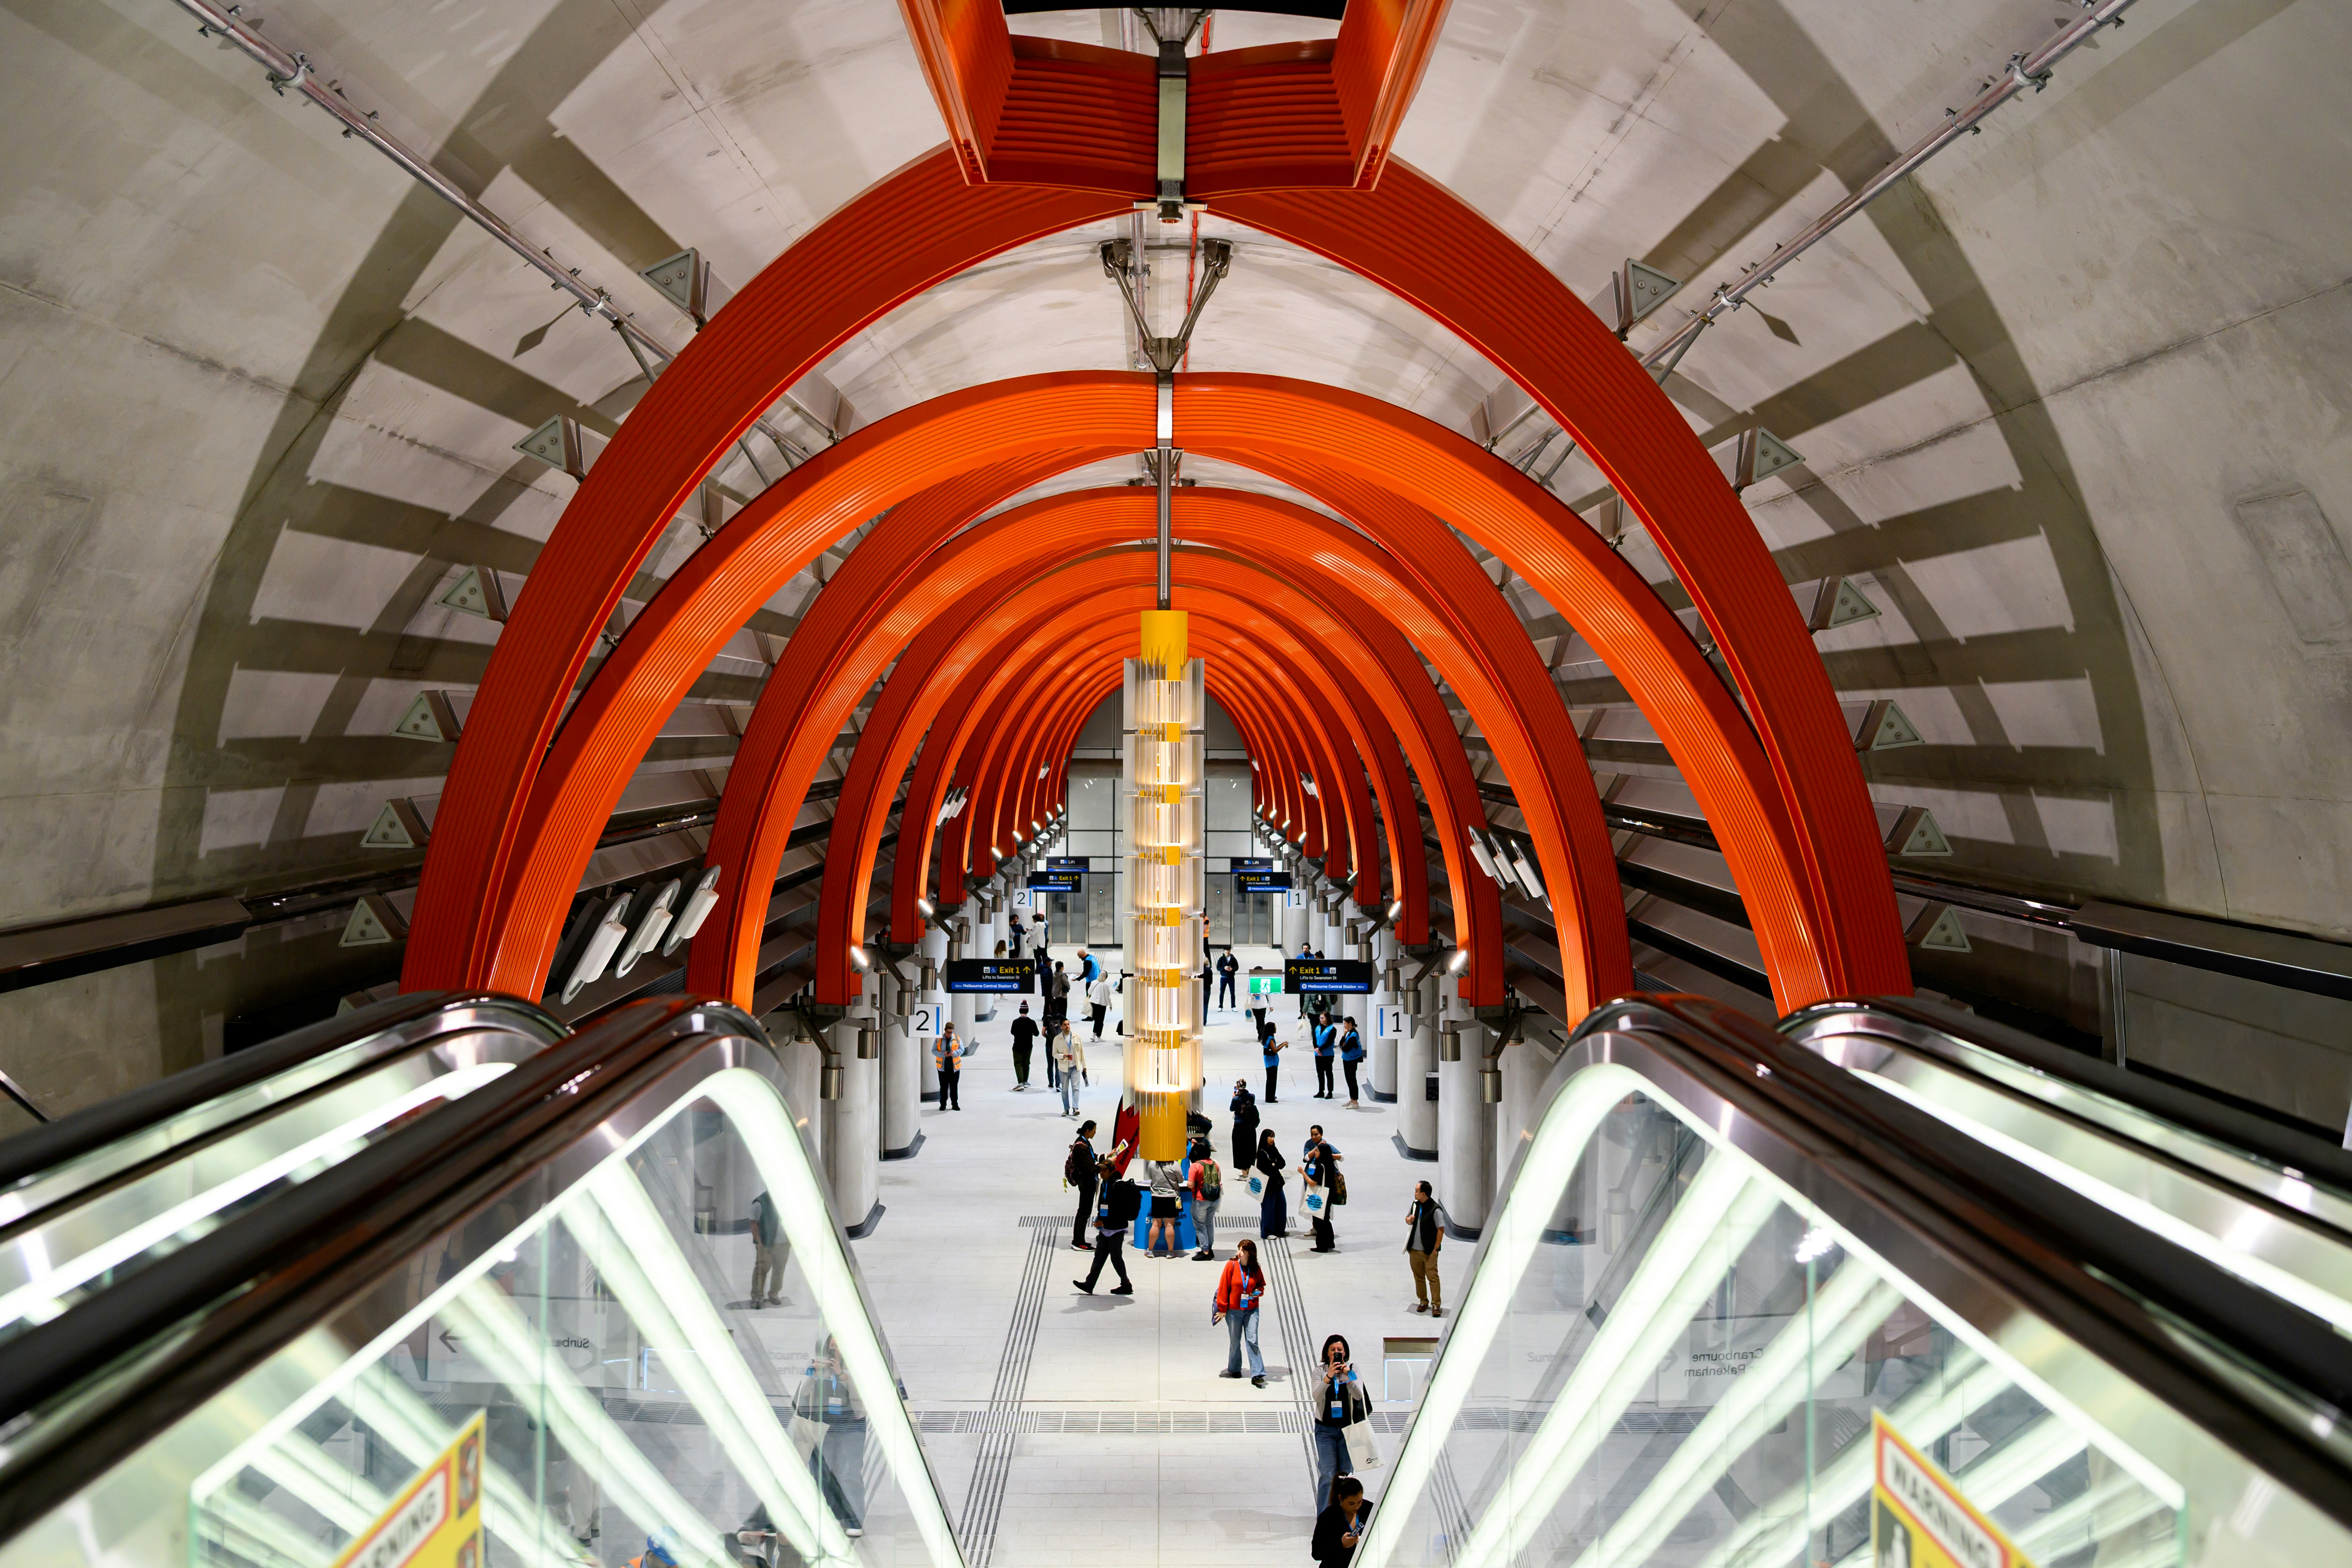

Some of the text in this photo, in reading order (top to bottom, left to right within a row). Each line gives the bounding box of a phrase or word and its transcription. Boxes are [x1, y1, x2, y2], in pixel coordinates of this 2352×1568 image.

[1017, 892, 1025, 904] 2
[1295, 893, 1301, 905] 1
[915, 1010, 929, 1031] 2
[1392, 1011, 1402, 1032] 1
[1119, 1148, 1130, 1166] State
[1892, 1453, 1992, 1568] WARNING
